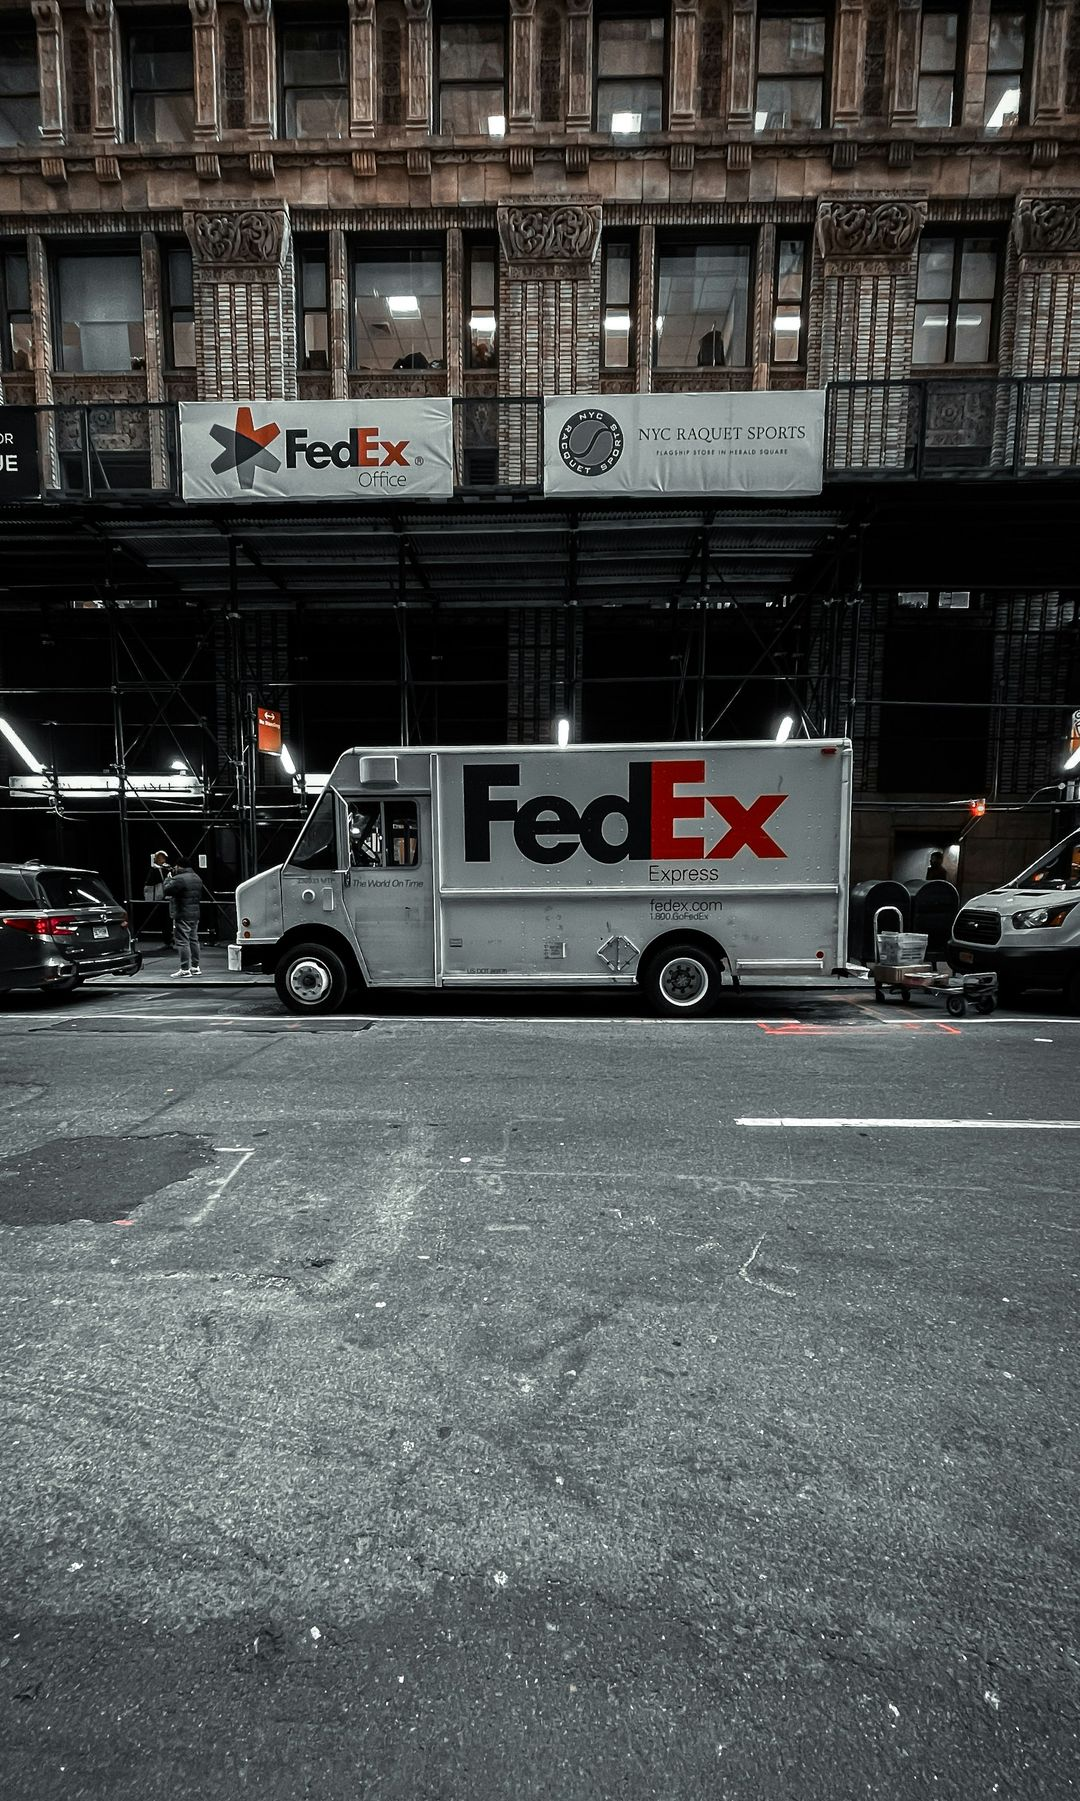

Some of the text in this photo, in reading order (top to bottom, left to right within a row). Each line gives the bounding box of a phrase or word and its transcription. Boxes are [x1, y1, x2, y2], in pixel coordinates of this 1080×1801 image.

[561, 411, 621, 474] NYC RACQUET SPORTS
[638, 426, 806, 443] NYC RAQUET SPORTS
[286, 427, 410, 470] FedEx
[358, 471, 407, 487] Office
[463, 760, 789, 864] FedEx
[353, 879, 424, 888] The World On Time
[649, 865, 719, 885] Express
[650, 899, 723, 912] fedex.com
